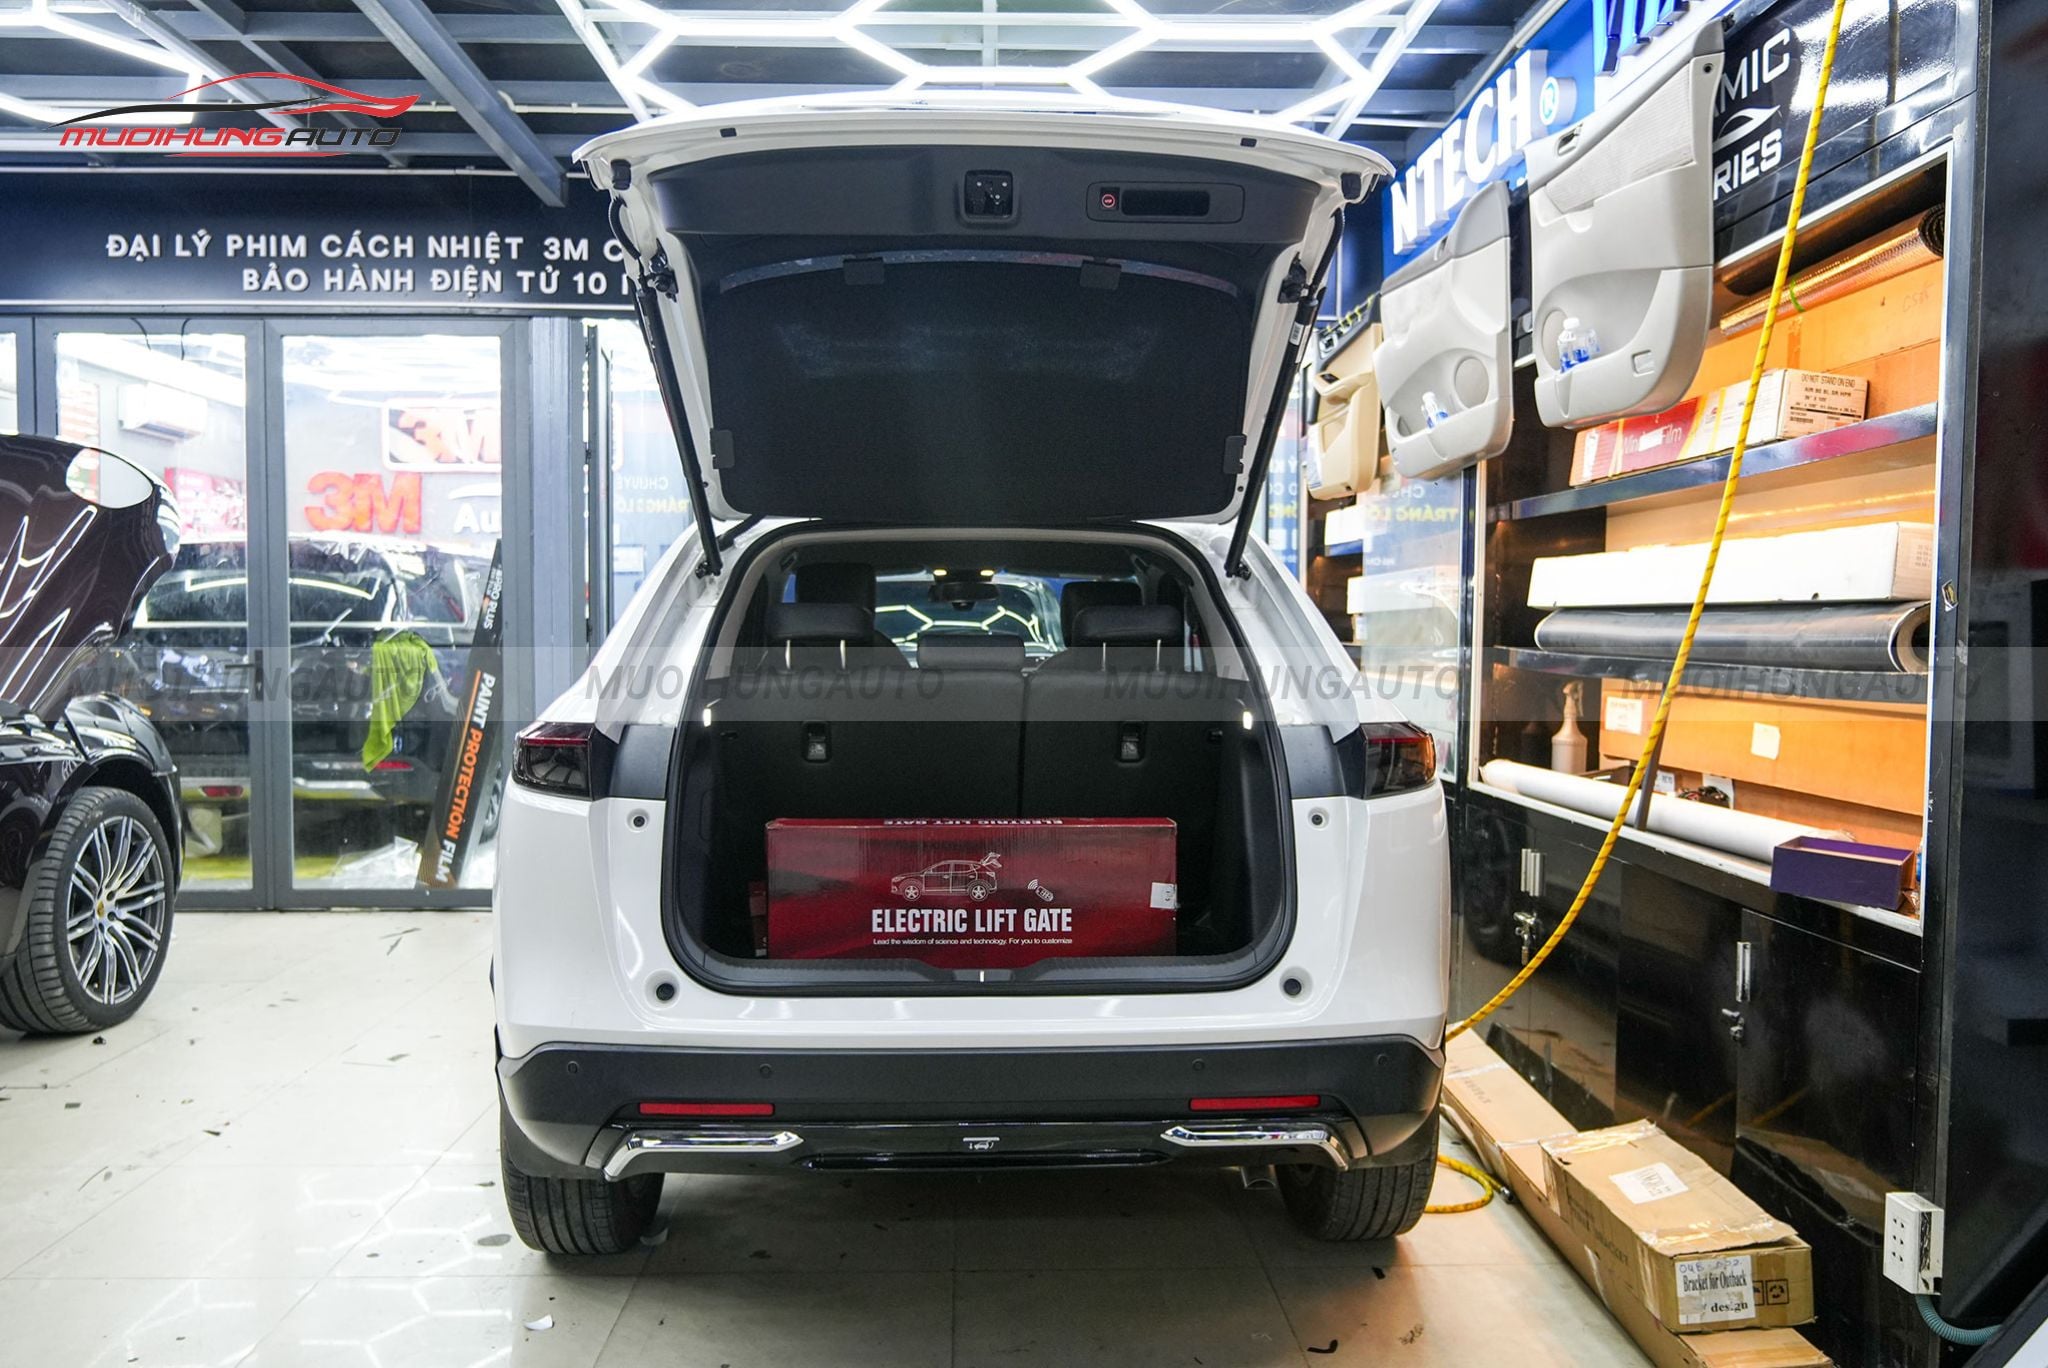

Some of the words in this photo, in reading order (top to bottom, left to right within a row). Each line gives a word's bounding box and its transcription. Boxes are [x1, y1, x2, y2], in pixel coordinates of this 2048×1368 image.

[1713, 128, 1783, 200] RIES
[106, 233, 161, 262] ĐẠI
[175, 228, 212, 258] LÝ
[226, 234, 308, 258] PHIM
[320, 228, 415, 259] CÁCH
[427, 230, 524, 265] NHIỆT
[543, 236, 589, 262] 3M
[603, 239, 624, 263] C
[242, 261, 310, 292] BẢO
[323, 263, 415, 293] HÀNH
[430, 264, 503, 298] ĐIỆN
[516, 264, 561, 295] TỬ
[573, 272, 608, 296] 10
[304, 472, 422, 533] 3M
[453, 502, 501, 533] Au
[482, 600, 499, 631] PLUS
[471, 672, 496, 729] PAINT
[446, 728, 483, 840] PROTECTION
[435, 838, 457, 883] FILM
[872, 909, 967, 932] ELECTRIC
[975, 908, 1017, 932] LIFT
[1023, 908, 1073, 932] GATE
[873, 937, 890, 945] Lead
[890, 937, 901, 945] the
[902, 937, 926, 945] wisdom
[927, 937, 934, 945] of
[935, 937, 958, 945] science
[959, 937, 972, 945] and
[973, 937, 1007, 946] technology.
[1008, 937, 1020, 945] For
[1683, 1274, 1708, 1293] Bracket
[1720, 1269, 1747, 1289] Outback
